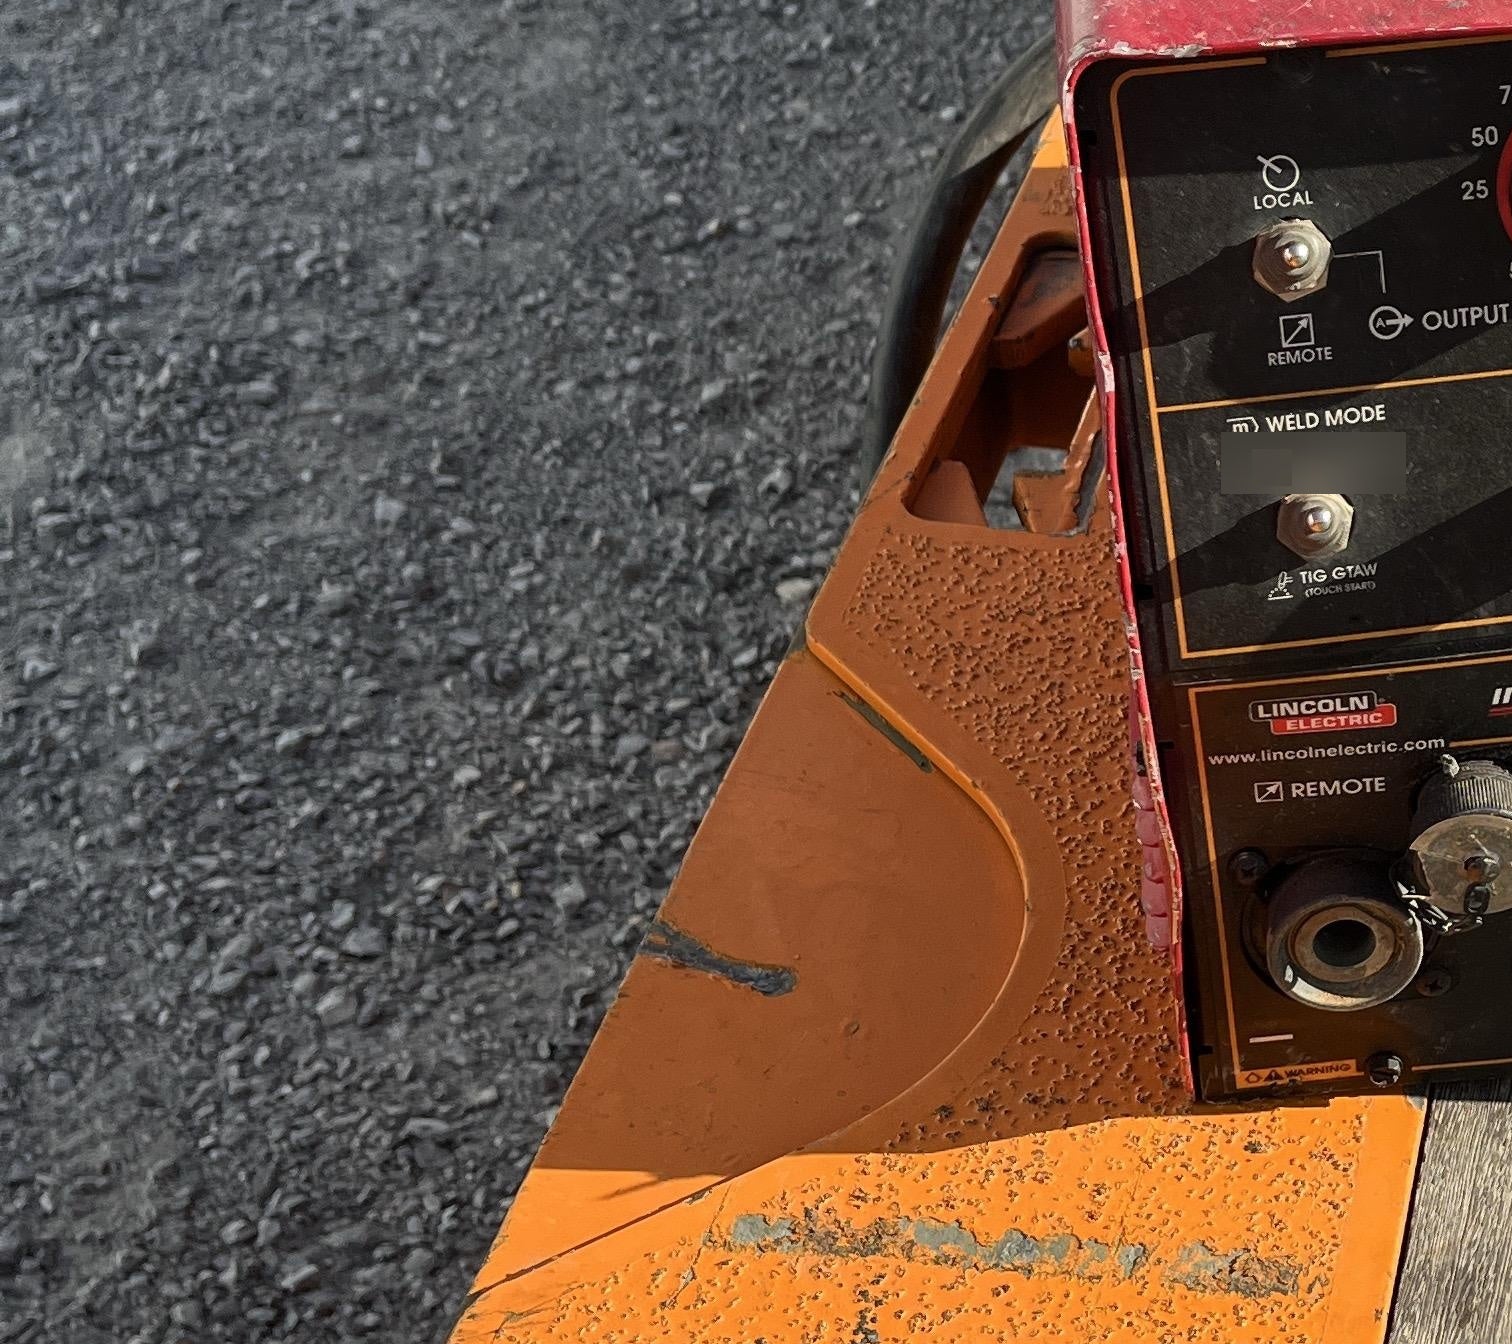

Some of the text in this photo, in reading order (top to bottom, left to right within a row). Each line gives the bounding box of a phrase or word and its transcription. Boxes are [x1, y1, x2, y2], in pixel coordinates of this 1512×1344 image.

[1471, 125, 1499, 147] 50
[1253, 190, 1314, 211] LOCAL
[1461, 179, 1489, 201] 25
[1421, 303, 1510, 331] OUTPUT
[1267, 346, 1333, 367] REMOTE
[1266, 404, 1387, 433] WELD MODE
[1299, 562, 1378, 584] TIG GTAW
[1258, 695, 1369, 719] LINCOLN
[1286, 712, 1384, 732] ELECTRIC
[1208, 736, 1445, 766] www.lincolnelectric.com
[1290, 776, 1386, 798] REMOTE
[1284, 1063, 1351, 1078] WARNING
